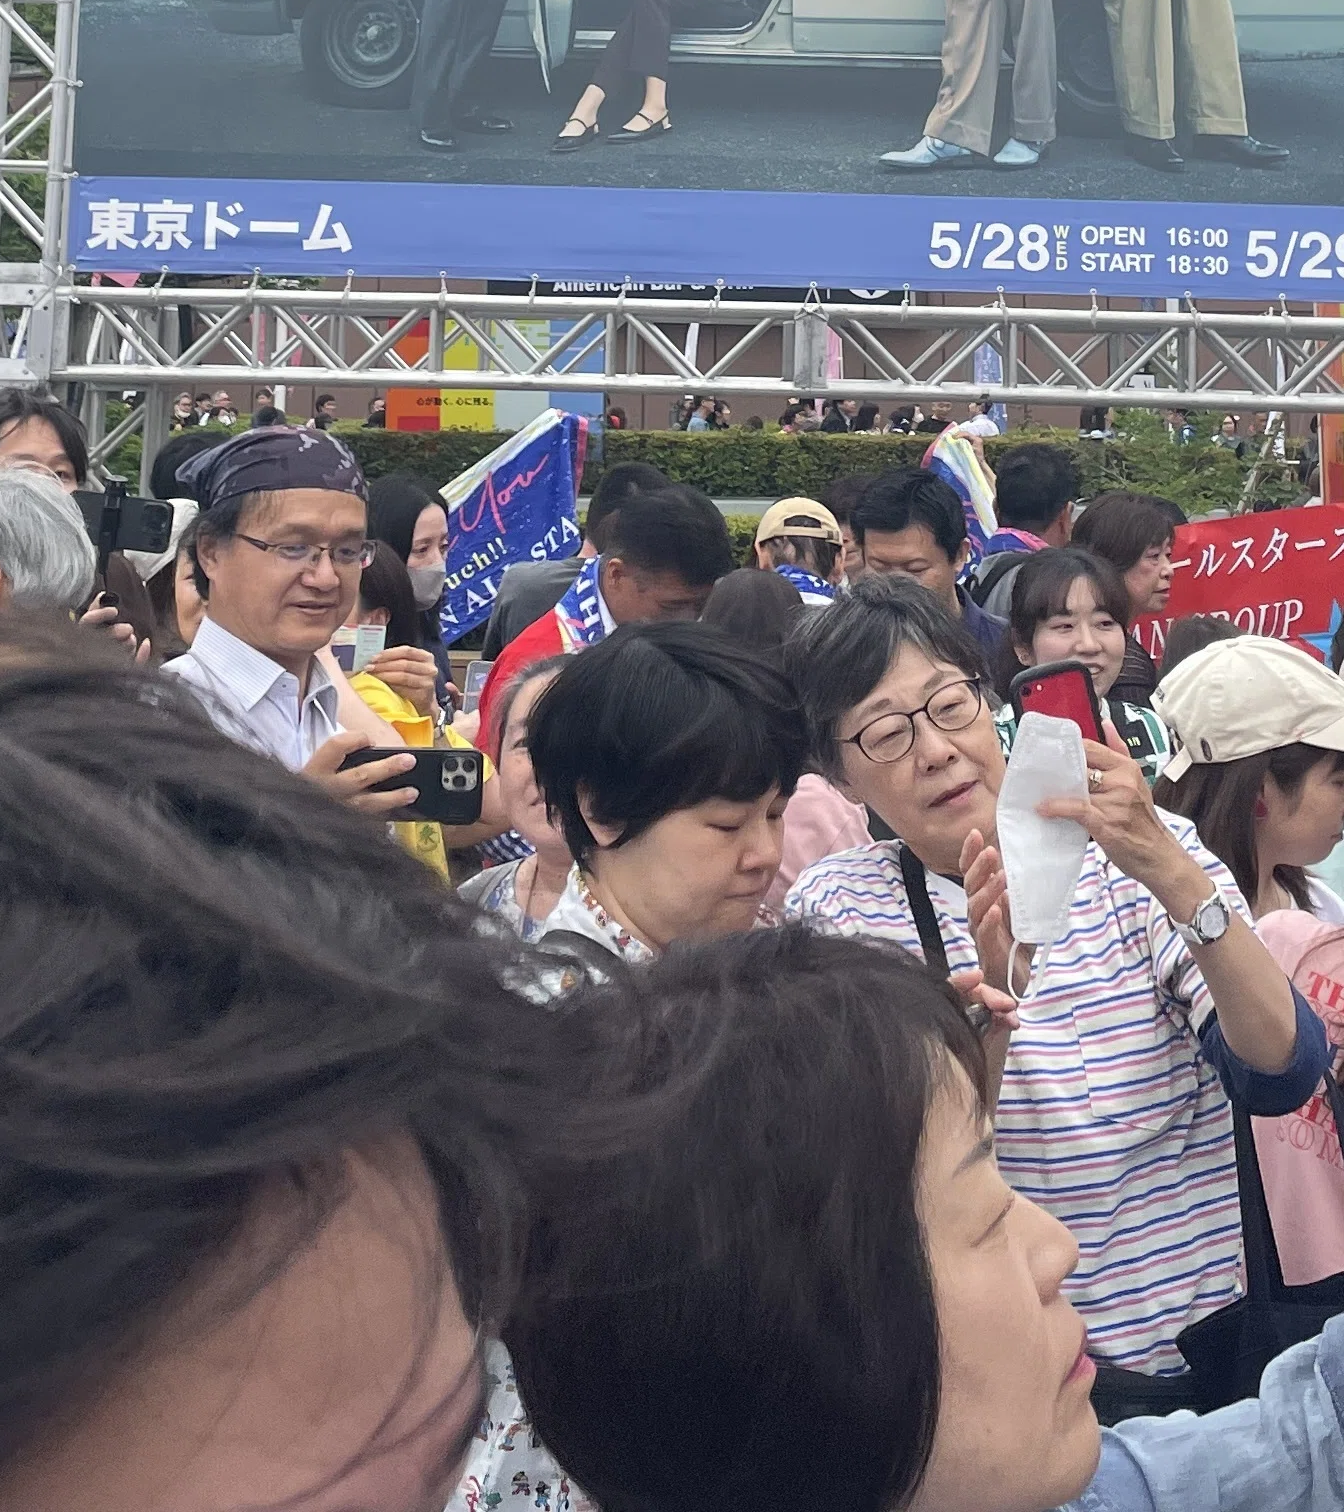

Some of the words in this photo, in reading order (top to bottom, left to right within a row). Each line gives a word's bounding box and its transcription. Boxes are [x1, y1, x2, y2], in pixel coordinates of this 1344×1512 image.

[86, 200, 353, 253] 東京ドーム
[928, 221, 1050, 272] 5/28
[1080, 225, 1146, 246] OPEN
[1166, 227, 1229, 248] 16:00
[1080, 252, 1156, 273] START
[1166, 255, 1229, 276] 18:30
[444, 537, 508, 591] uch!!
[530, 516, 580, 563] STA
[1192, 598, 1304, 640] OUP
